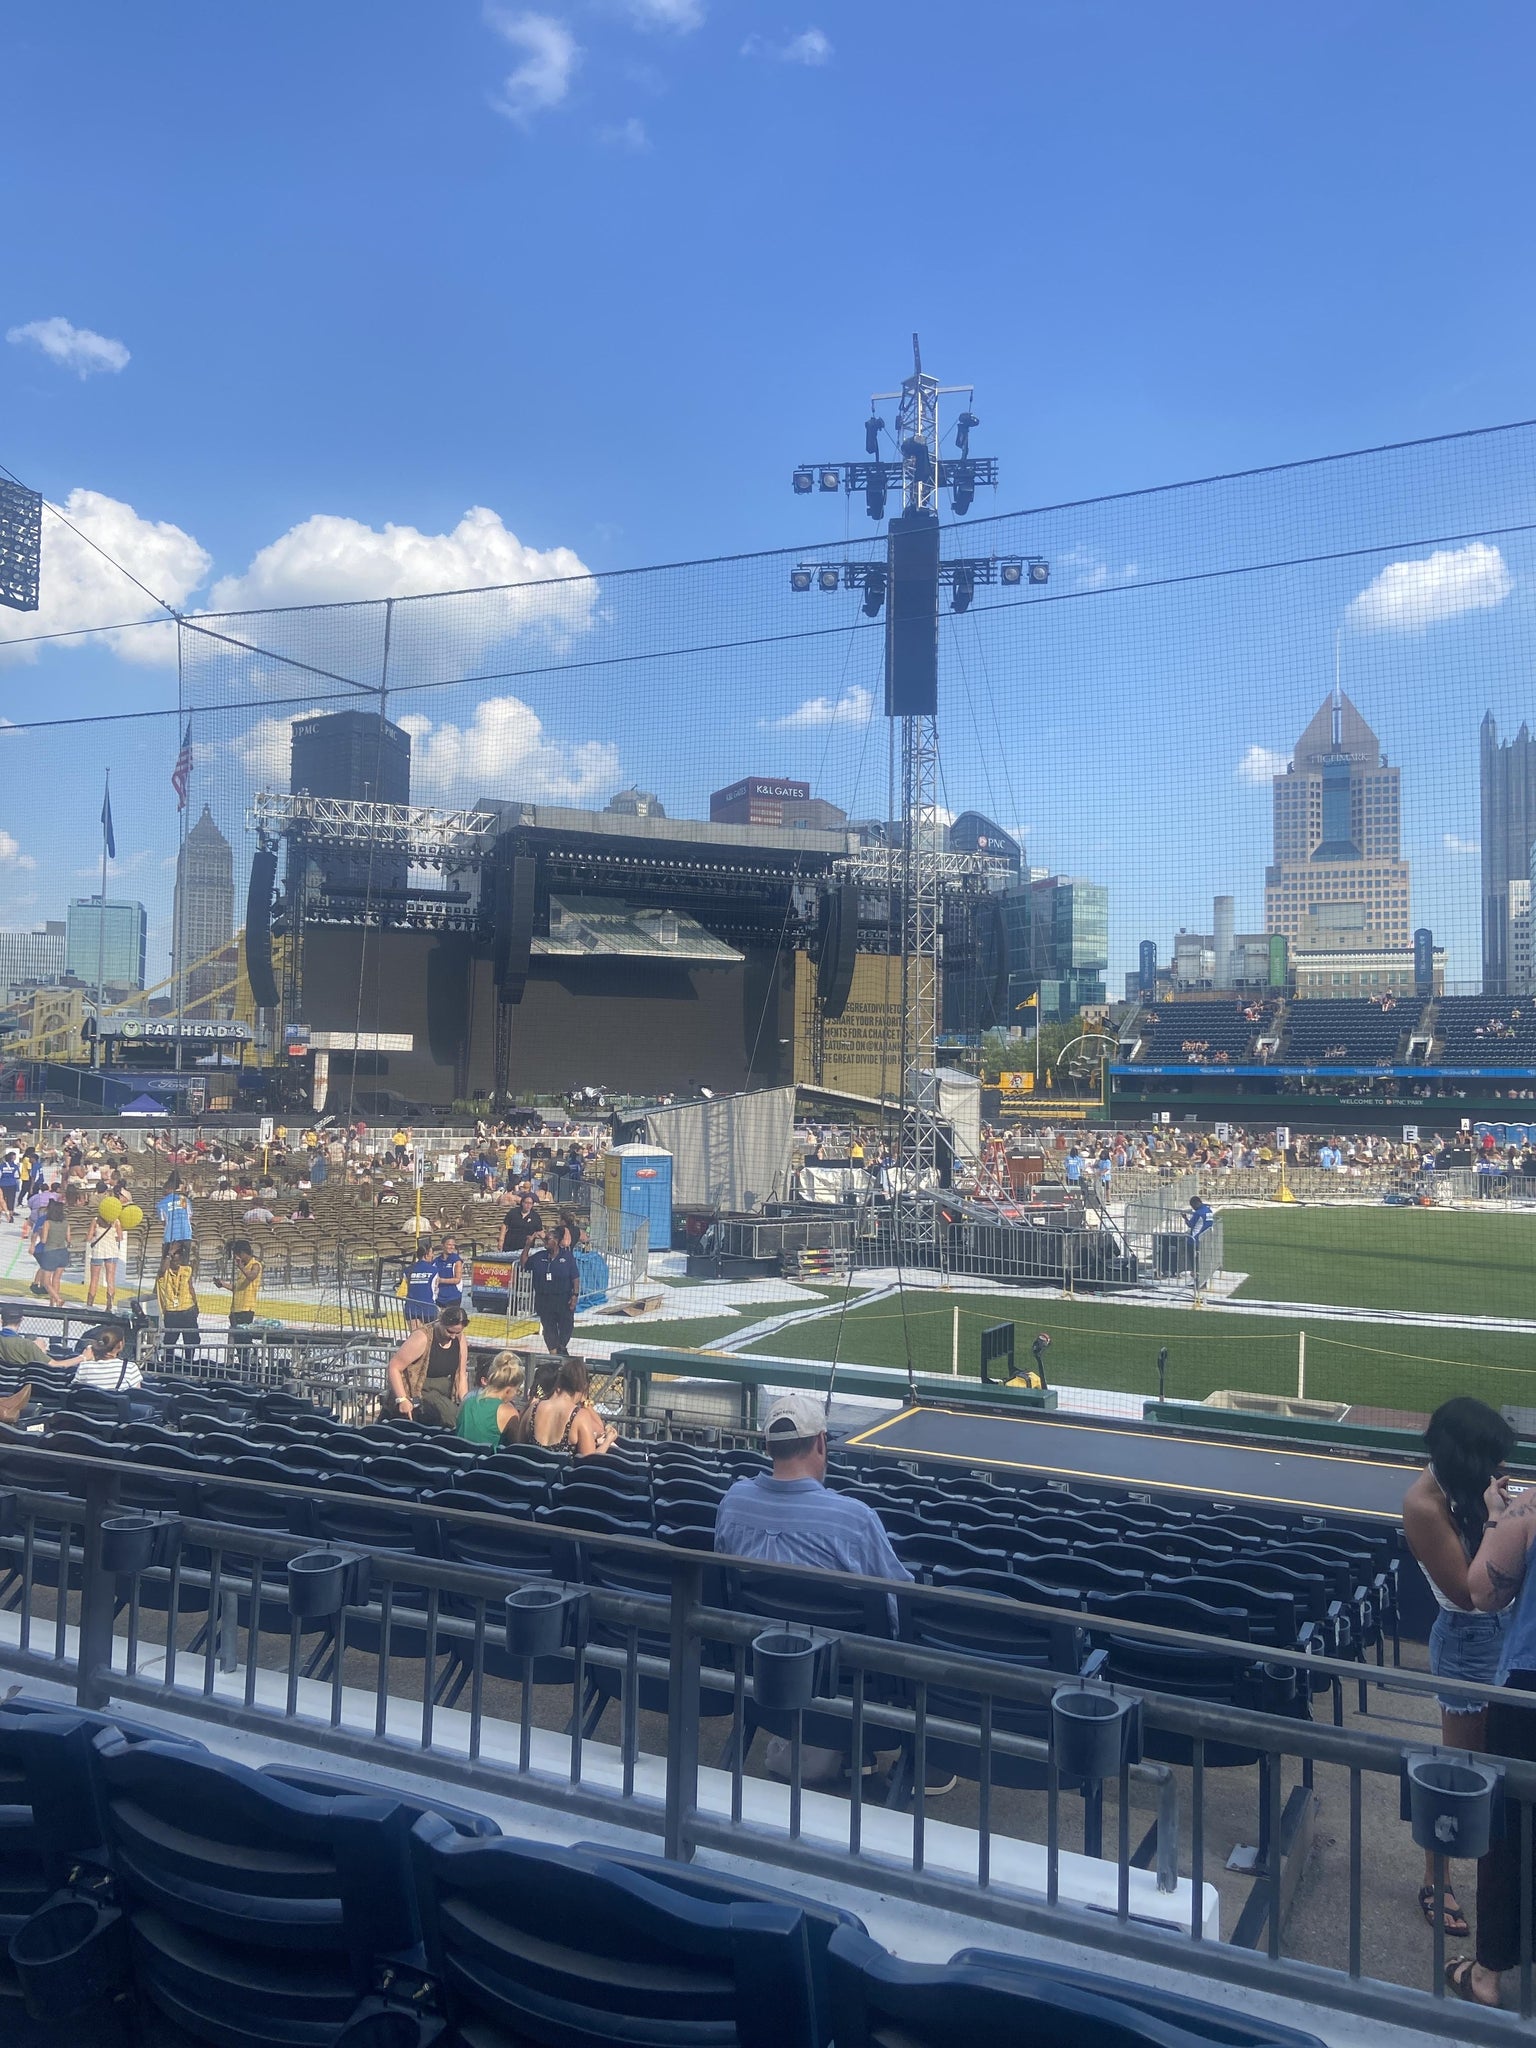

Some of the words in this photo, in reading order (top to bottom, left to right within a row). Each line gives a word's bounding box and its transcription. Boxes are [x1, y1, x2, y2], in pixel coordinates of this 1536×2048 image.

[292, 723, 320, 738] UPMC
[756, 785, 773, 795] K&L
[774, 787, 805, 798] GATES
[987, 837, 1006, 849] PNC
[856, 1016, 875, 1027] YOUR
[875, 1016, 904, 1028] FAVORIT
[144, 1023, 175, 1036] FAT
[180, 1024, 245, 1038] HEAD'S
[824, 1028, 848, 1039] MENTS
[848, 1029, 863, 1039] FOR
[824, 1040, 855, 1051] EATURED
[855, 1041, 866, 1052] ON
[832, 1053, 856, 1065] GREAT
[856, 1053, 879, 1065] DIVIDE
[265, 1125, 271, 1139] J
[1218, 1129, 1224, 1139] F
[1407, 1131, 1414, 1140] E
